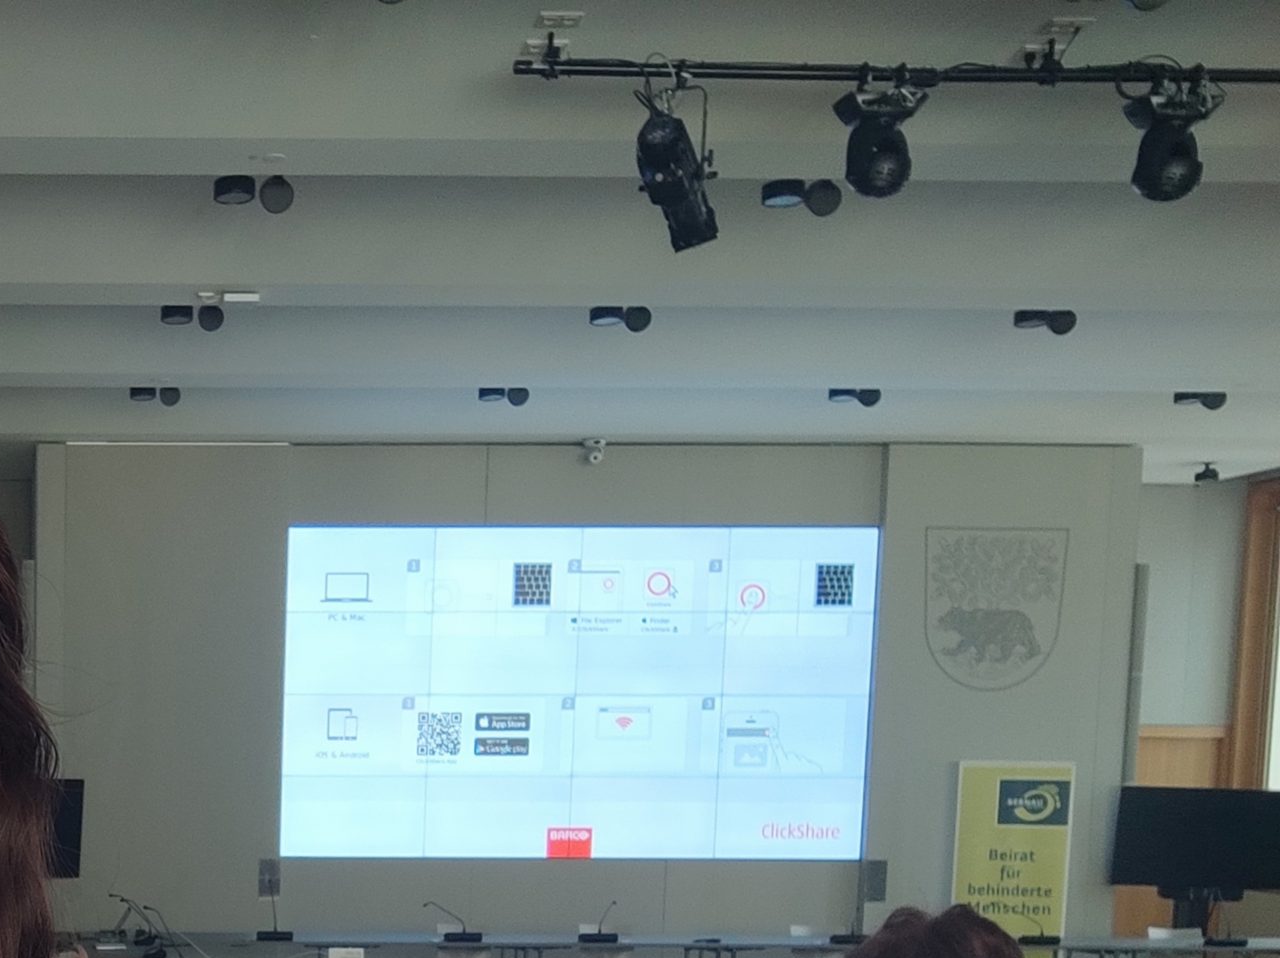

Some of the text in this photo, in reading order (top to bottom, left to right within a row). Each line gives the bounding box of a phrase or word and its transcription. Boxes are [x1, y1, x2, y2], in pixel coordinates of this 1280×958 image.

[491, 719, 527, 730] App Store
[761, 822, 840, 840] ClickShare
[988, 848, 1036, 863] Beirat
[1000, 864, 1021, 881] für
[966, 882, 1053, 898] behinderte
